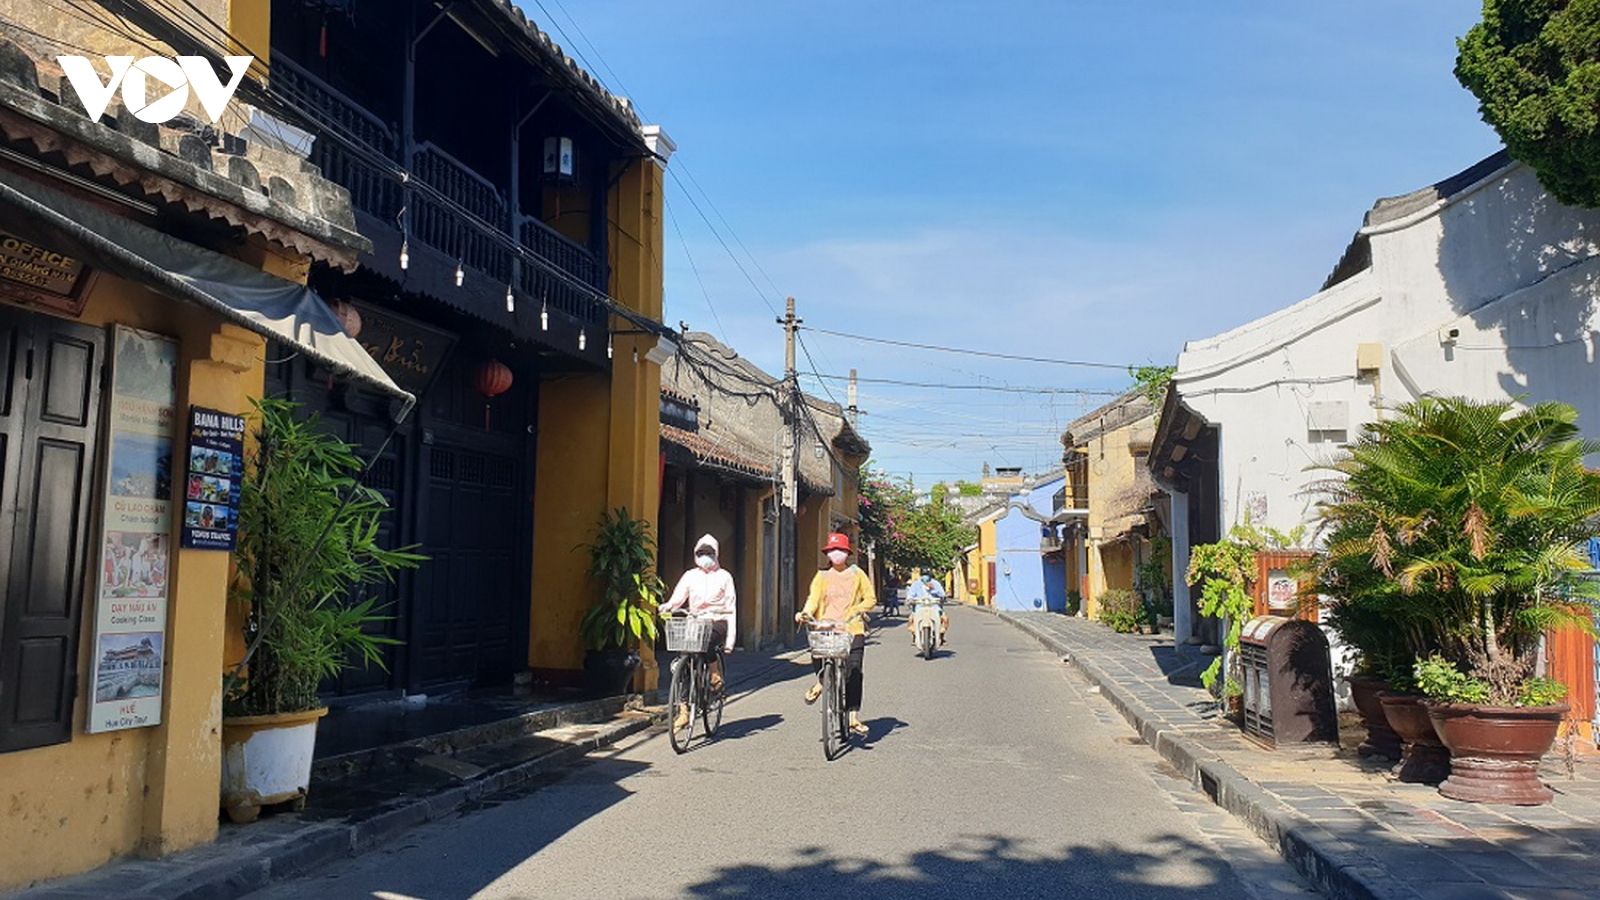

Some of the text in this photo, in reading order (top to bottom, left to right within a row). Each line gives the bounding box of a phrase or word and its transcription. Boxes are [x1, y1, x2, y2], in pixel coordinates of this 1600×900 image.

[3, 238, 76, 269] OFFICE
[194, 411, 245, 433] BANA HILLS
[128, 502, 143, 512] LAO
[110, 615, 156, 626] Cooking Class
[105, 715, 148, 728] Hue City Tour
